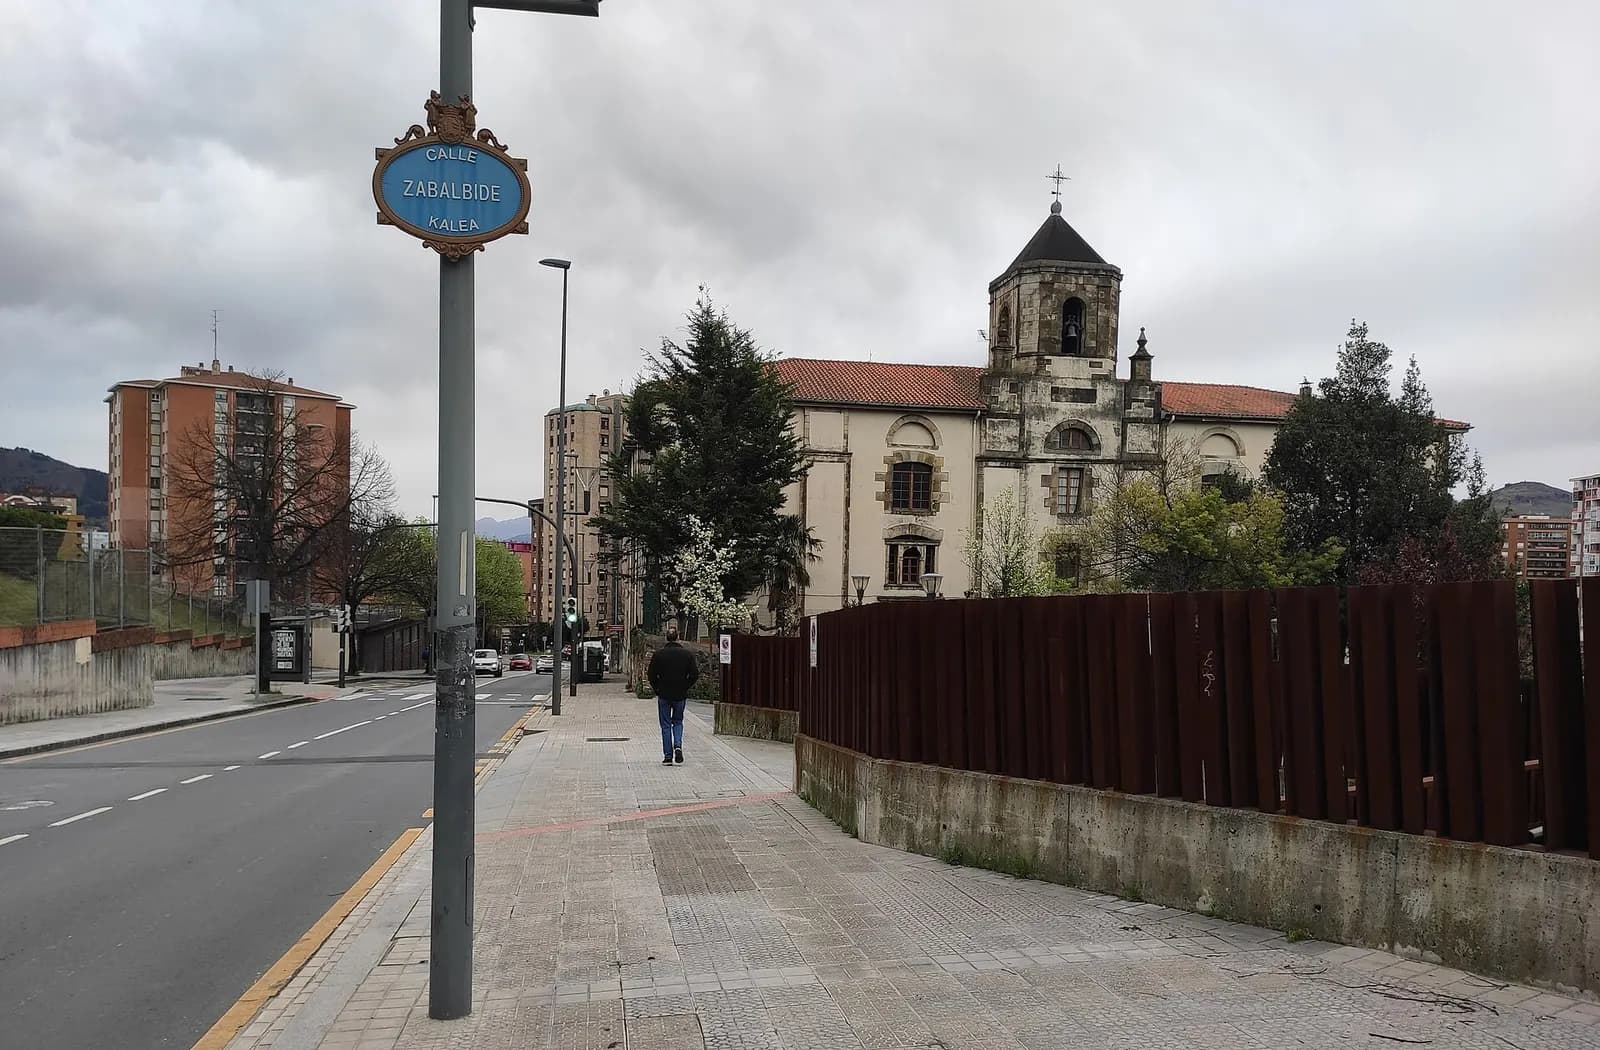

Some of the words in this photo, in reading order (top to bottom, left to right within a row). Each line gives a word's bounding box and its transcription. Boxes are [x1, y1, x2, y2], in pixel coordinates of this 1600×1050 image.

[426, 148, 478, 163] CALLE
[403, 180, 501, 202] ZABALBIDE
[428, 215, 479, 232] KALEA
